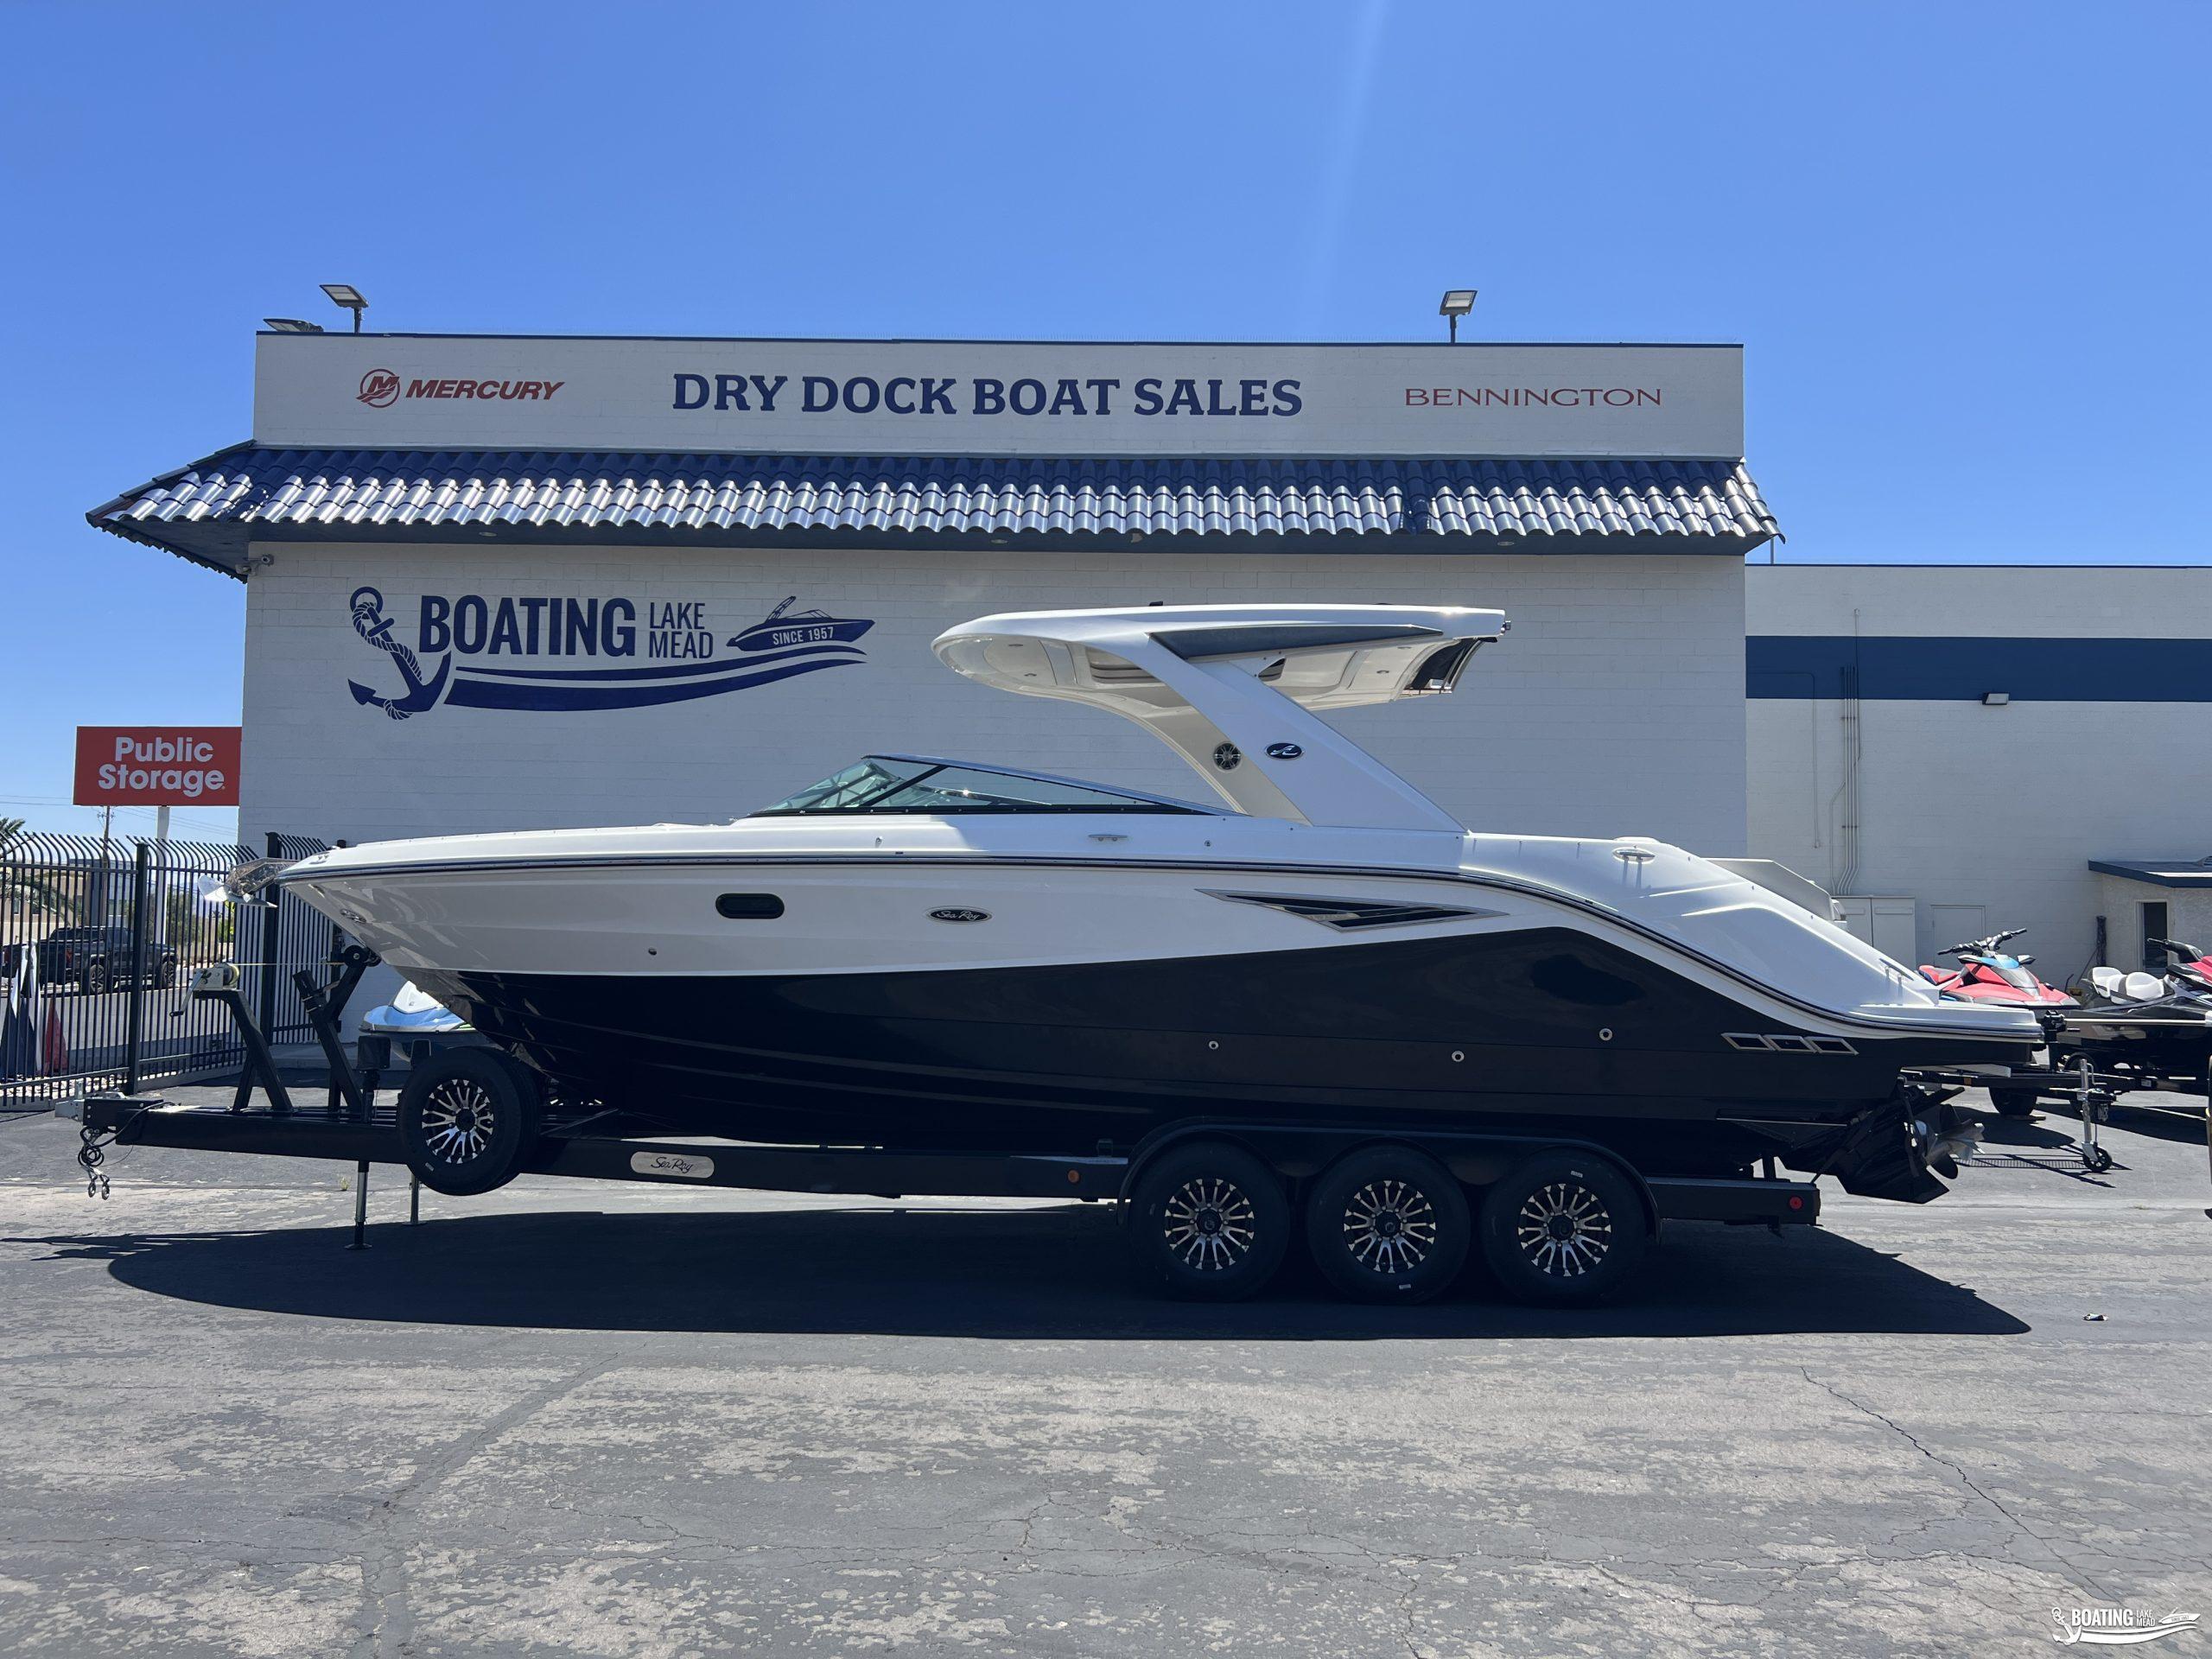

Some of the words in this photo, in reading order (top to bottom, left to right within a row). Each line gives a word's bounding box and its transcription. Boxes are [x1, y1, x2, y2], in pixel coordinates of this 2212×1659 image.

[405, 379, 566, 400] MERCURY
[672, 373, 788, 411] DRY
[801, 376, 957, 415] DOCK
[972, 378, 1121, 416] BOAT
[1134, 378, 1303, 416] SALES
[1405, 388, 1662, 406] BENNINGTON
[419, 594, 635, 657] BOATING
[649, 601, 706, 630] LAKE
[649, 631, 714, 658] MEAD
[772, 628, 804, 645] SINCE
[807, 626, 835, 641] 1957
[115, 736, 214, 763] Public
[98, 763, 225, 798] Storage
[651, 1156, 671, 1168] Sea
[671, 1158, 694, 1173] Ray
